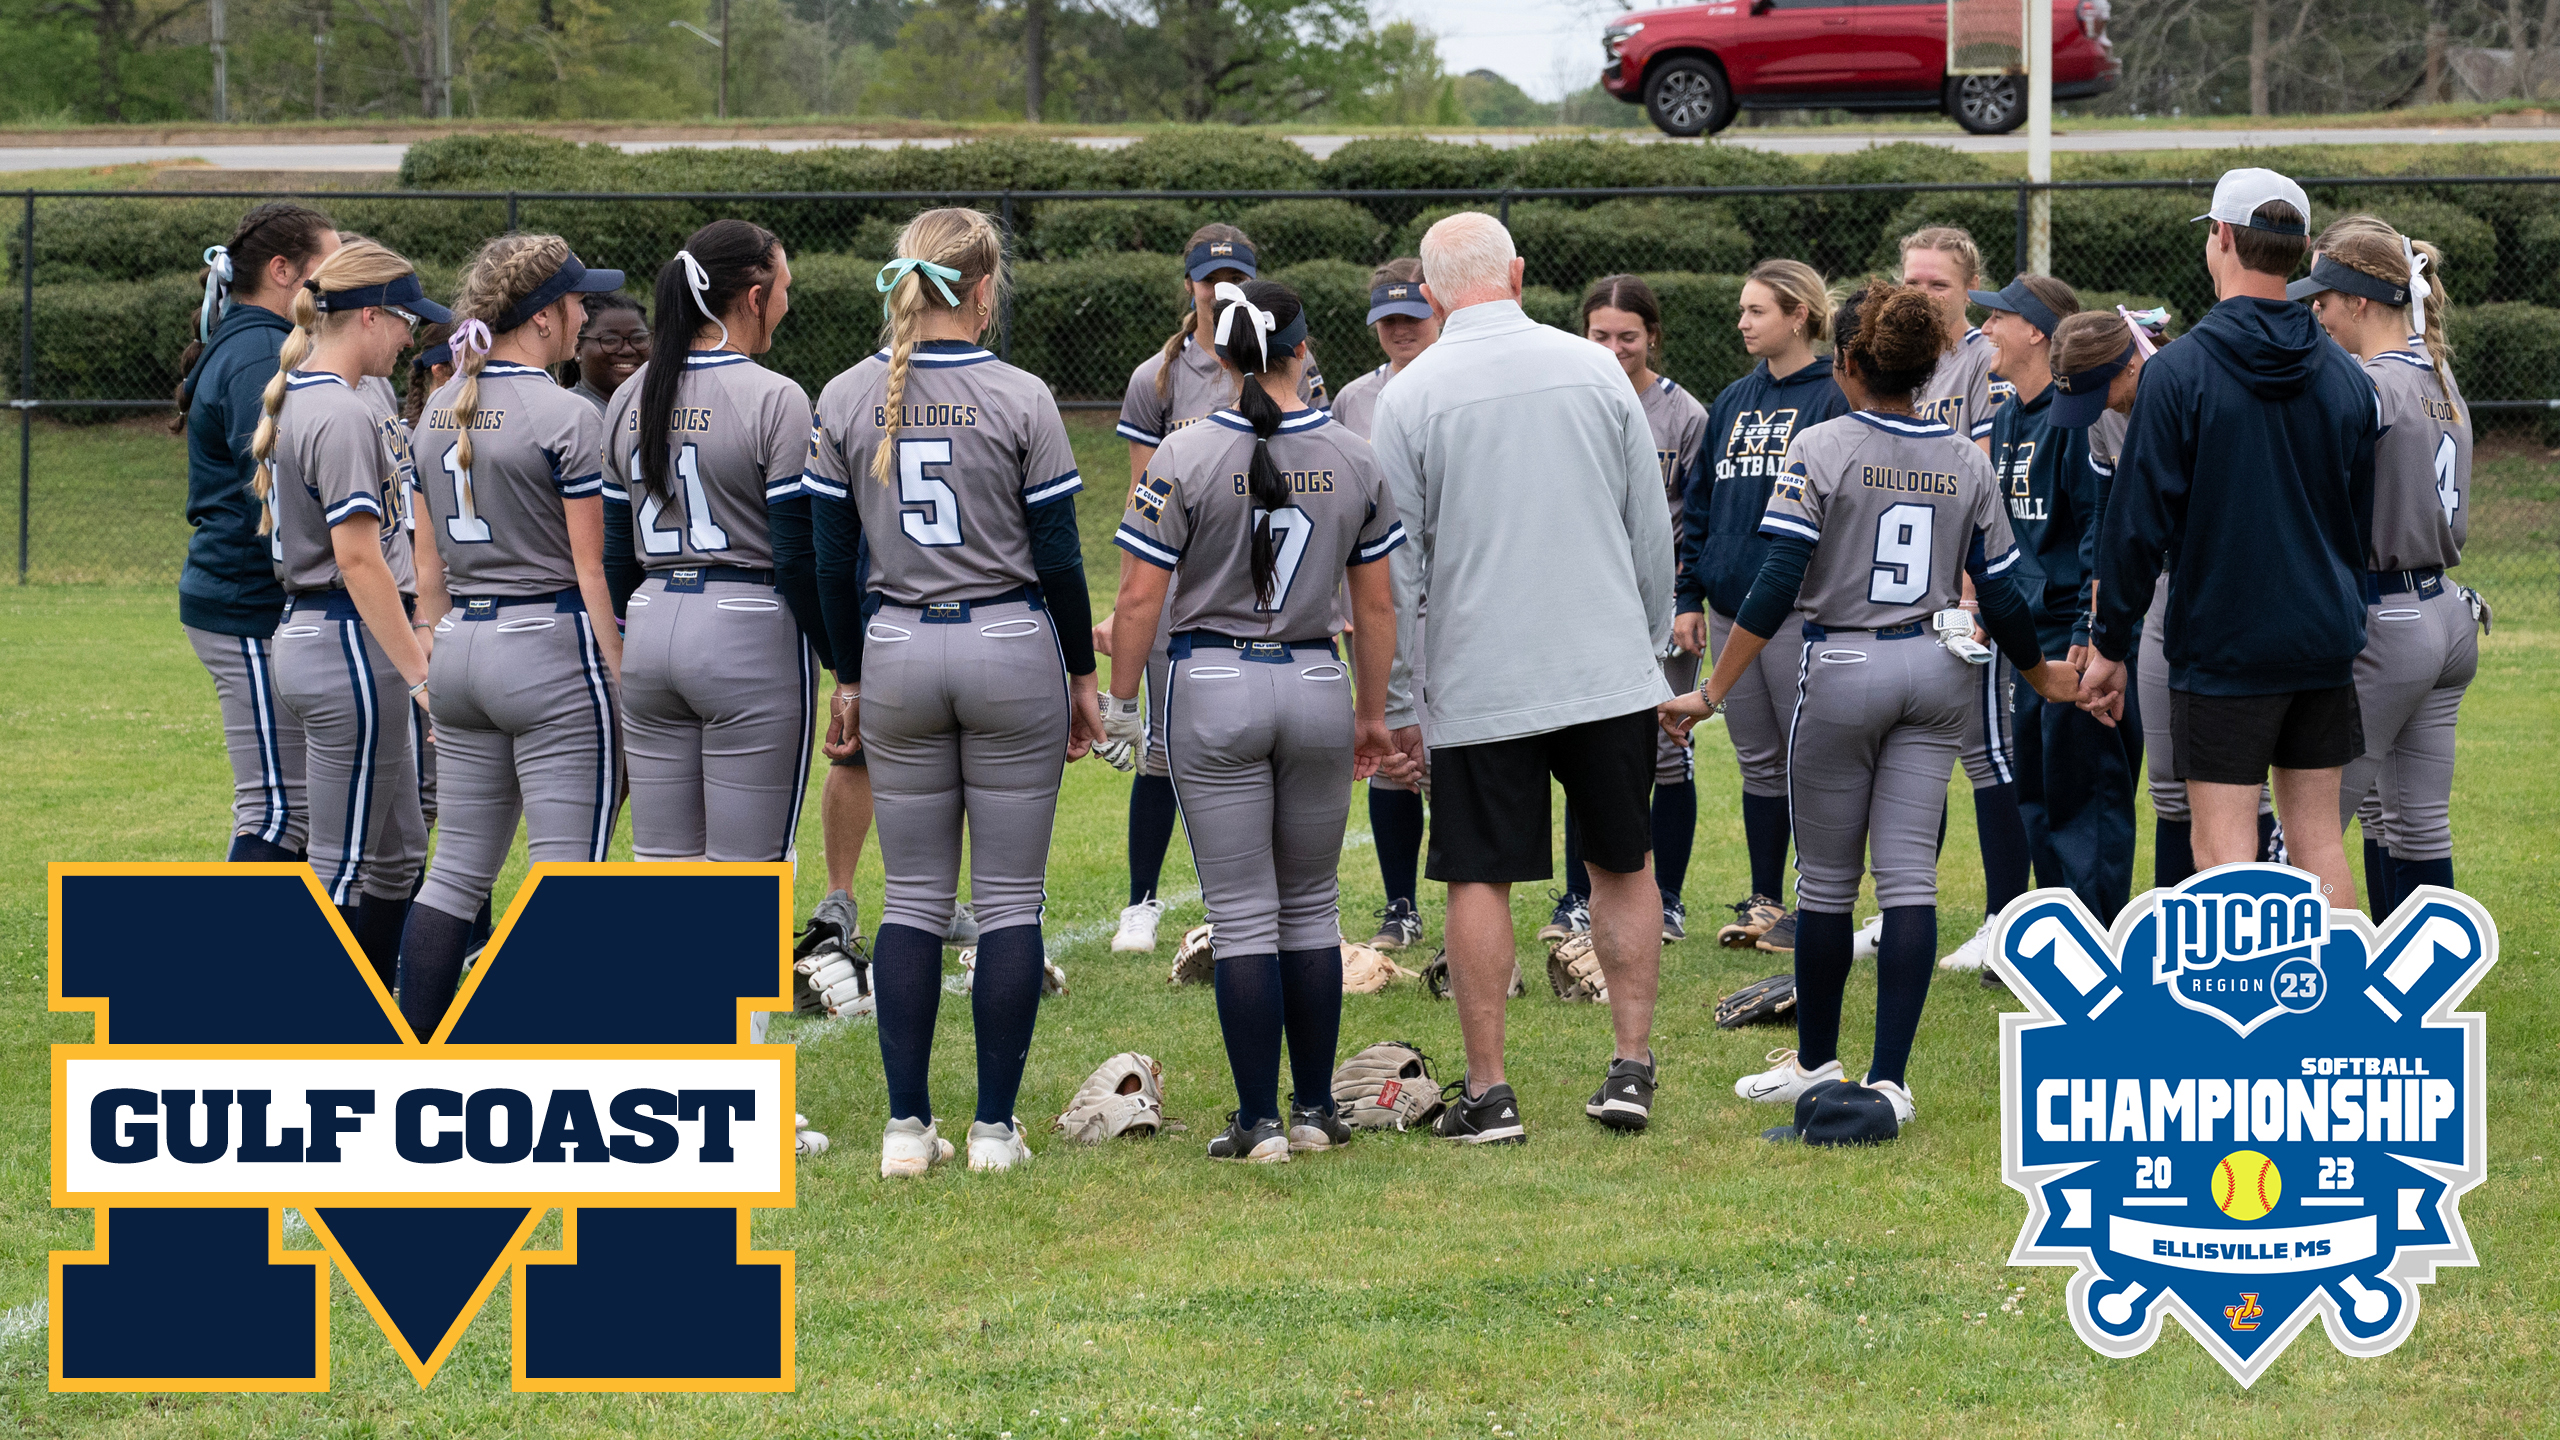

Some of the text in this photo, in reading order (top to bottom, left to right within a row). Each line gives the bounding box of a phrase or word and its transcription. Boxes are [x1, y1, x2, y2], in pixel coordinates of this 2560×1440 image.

[873, 403, 978, 429] BLLDOGS
[441, 440, 494, 545] 1
[631, 442, 731, 557] 21
[896, 438, 965, 547] 5
[1143, 490, 1164, 507] COAST
[1861, 464, 1958, 497] BULLDOGS
[2434, 430, 2460, 529] 4
[1251, 504, 1315, 613] 7
[1867, 501, 1937, 606] 9
